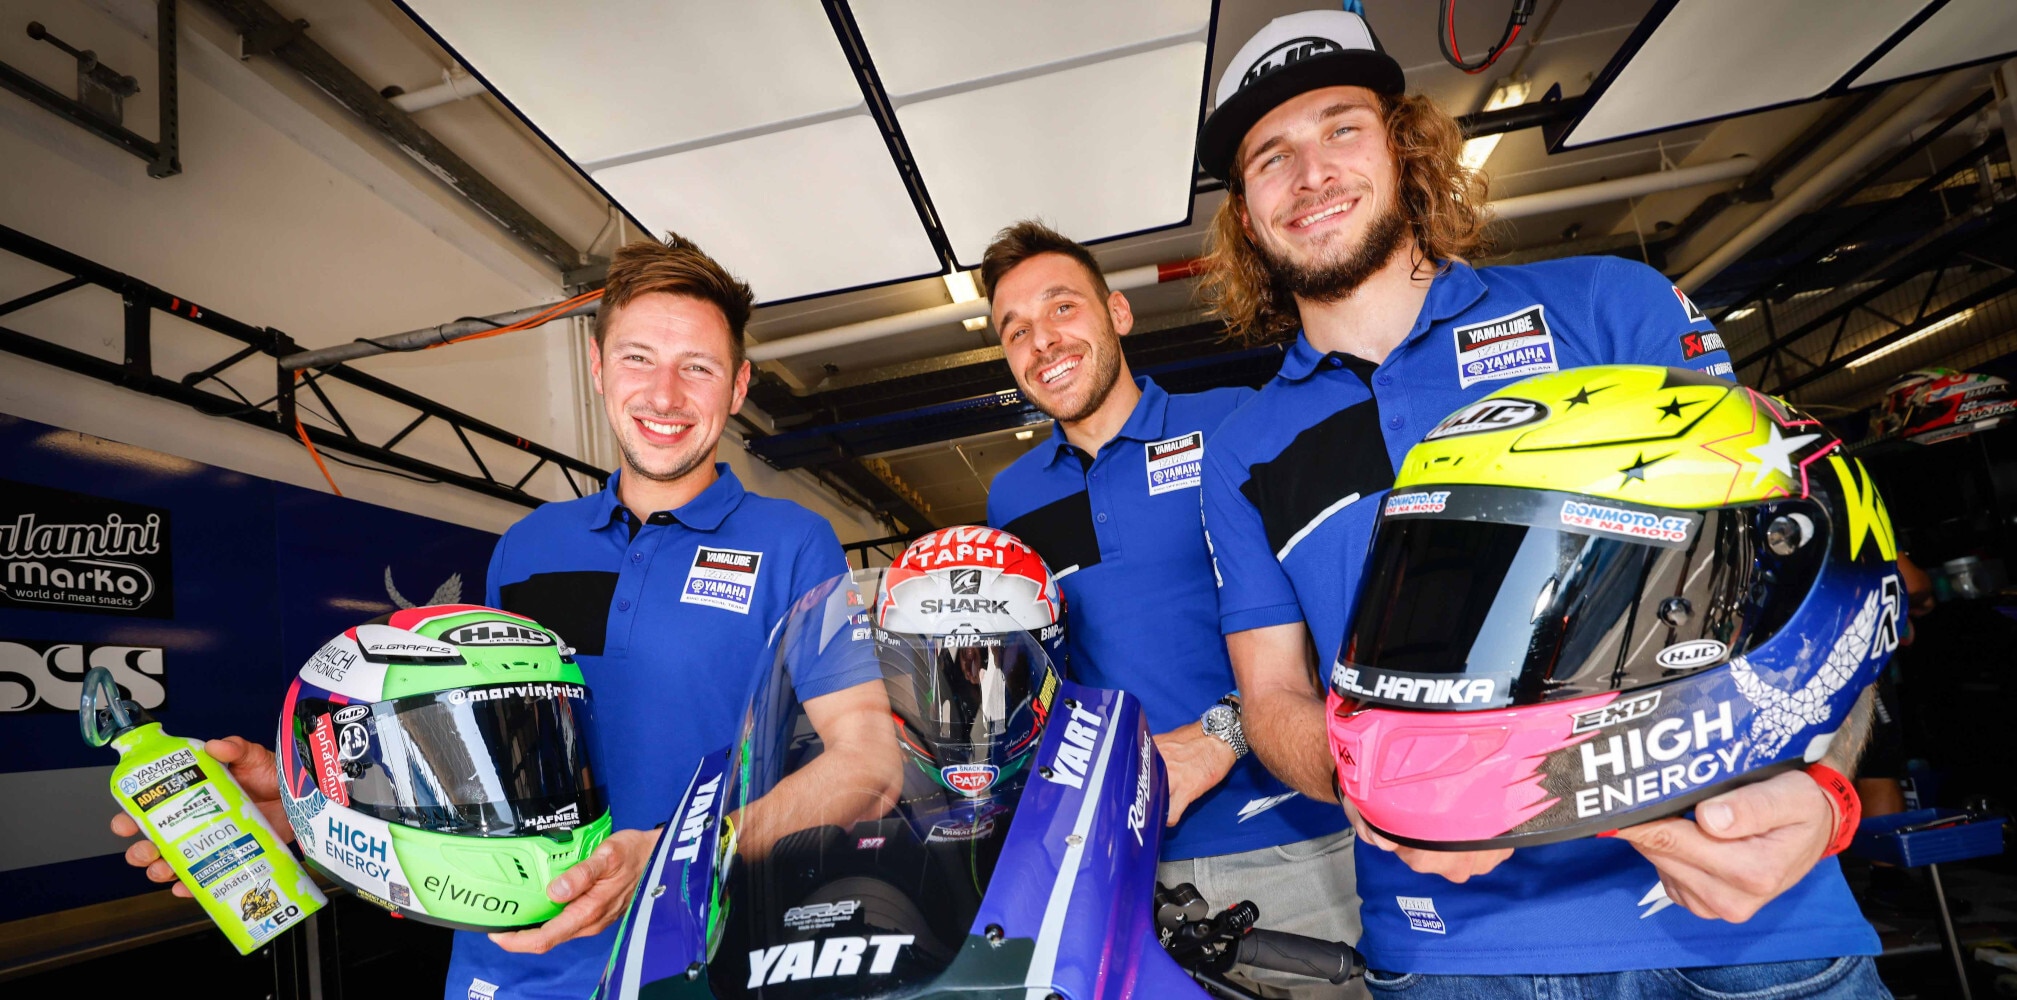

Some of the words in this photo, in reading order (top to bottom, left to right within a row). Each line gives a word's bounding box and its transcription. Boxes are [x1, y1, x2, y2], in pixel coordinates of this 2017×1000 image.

[1468, 315, 1534, 343] YAMALUBE
[1485, 347, 1546, 369] YAMAHA
[1154, 436, 1194, 455] YAMALUBE
[1164, 462, 1201, 478] YAMAHA
[1564, 503, 1686, 531] BONMOTO.CZ
[1600, 520, 1625, 531] NA
[1630, 526, 1684, 540] MOTO
[706, 552, 752, 567] YAMALUBE
[916, 543, 1004, 568] TAPPI
[15, 588, 50, 599] world
[53, 590, 65, 600] of
[68, 593, 96, 604] meat
[98, 595, 133, 606] snacks
[704, 580, 747, 599] YAMAHA
[920, 599, 1010, 614] SHARK
[459, 626, 545, 643] HJC
[944, 635, 980, 648] BMP
[980, 638, 1001, 647] TAPPI
[1040, 624, 1059, 642] BMP
[1668, 647, 1717, 662] HJC
[338, 709, 364, 720] HJC
[1047, 700, 1102, 790] YART
[1580, 702, 1734, 783] HIGH
[133, 749, 193, 781] YAMAICHI
[139, 757, 197, 787] ELECTRONICS
[959, 765, 982, 773] SNACK
[952, 775, 988, 790] PATA
[1575, 742, 1744, 818] ENERGY
[158, 795, 214, 829] HÄFNER
[525, 812, 580, 828] HÄFNER
[671, 771, 723, 864] YART
[328, 816, 387, 862] HIGH
[195, 853, 235, 880] EURONICS
[240, 844, 256, 855] XXL
[325, 839, 391, 882] ENERGY
[212, 862, 267, 899] alphatonus
[1422, 919, 1442, 929] SHOP
[747, 935, 915, 989] YART
